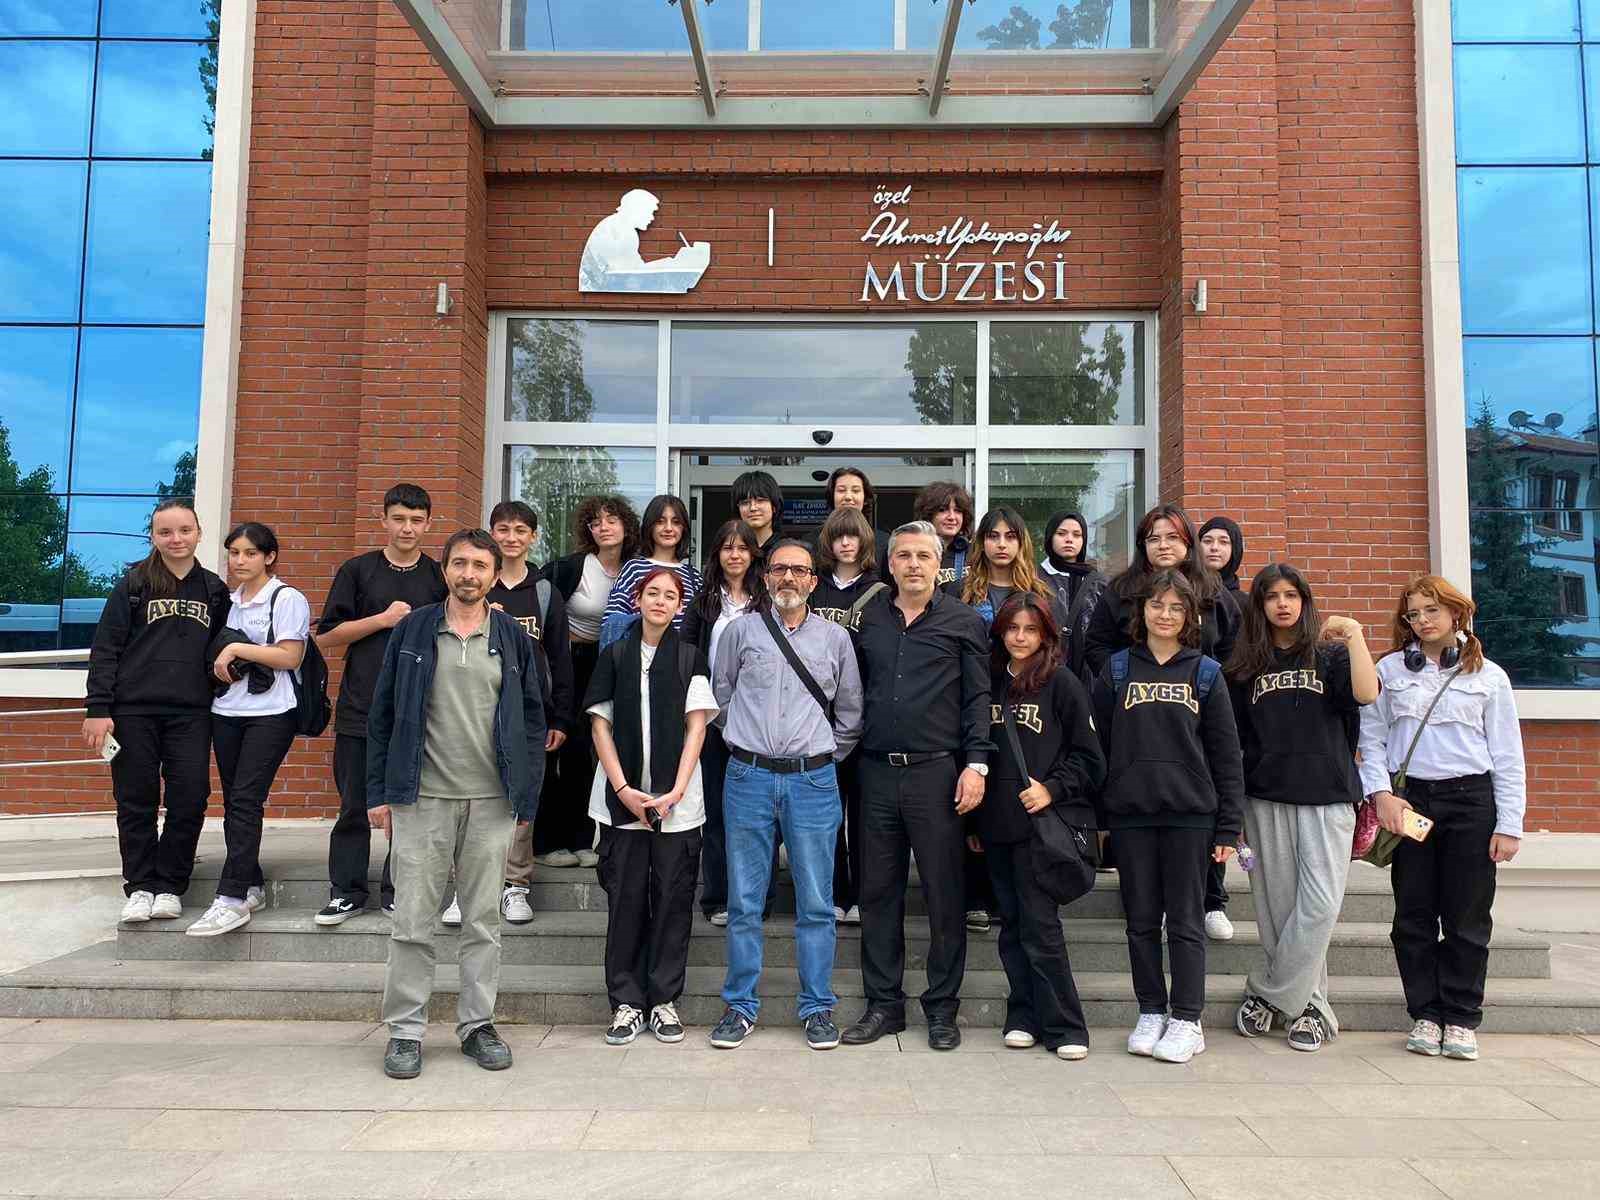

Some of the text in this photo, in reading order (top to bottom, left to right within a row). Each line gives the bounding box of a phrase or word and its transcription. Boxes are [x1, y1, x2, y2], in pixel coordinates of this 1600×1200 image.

[873, 185, 912, 211] özel
[861, 211, 948, 248] Ahmet
[858, 252, 1070, 302] MÜZESİ
[147, 598, 211, 628] AYGSL
[1124, 682, 1199, 714] AYGSL
[1252, 669, 1324, 705] AYGSL
